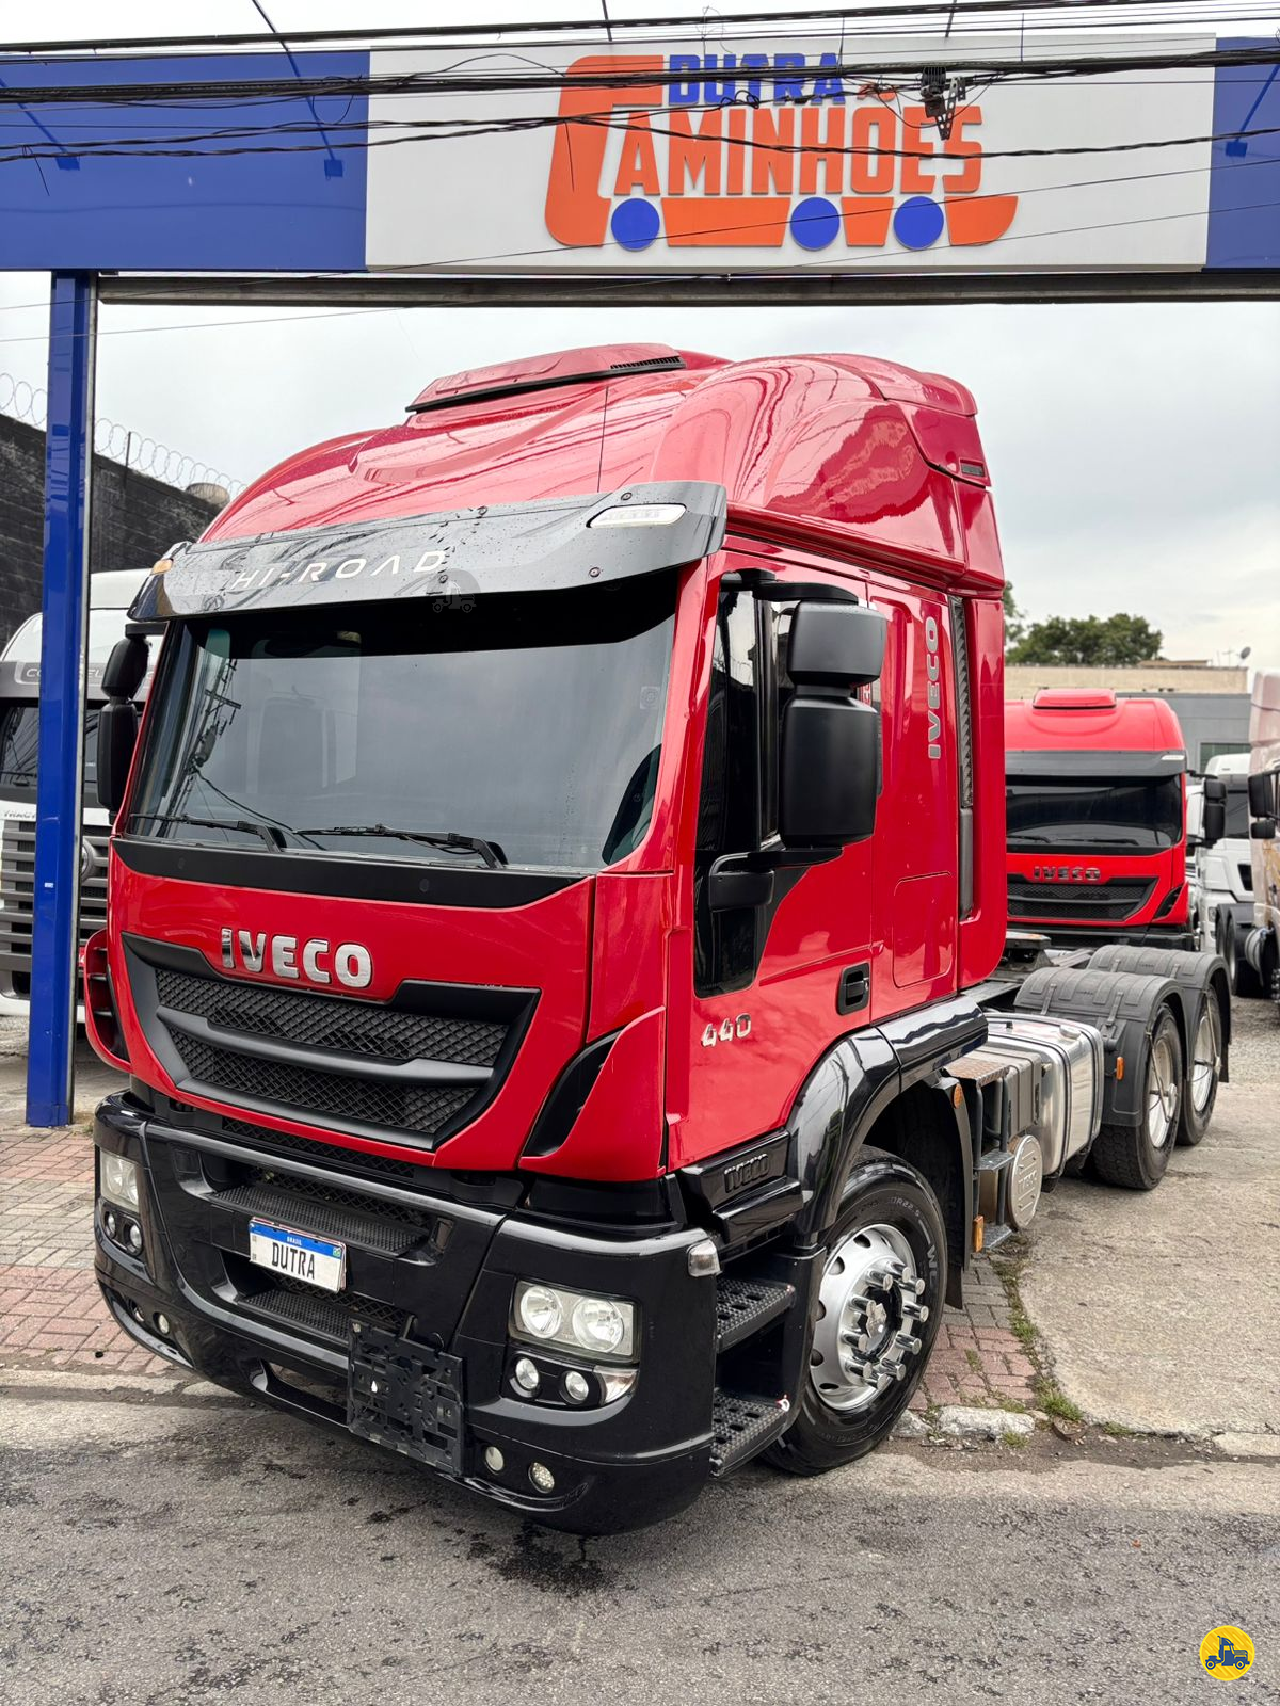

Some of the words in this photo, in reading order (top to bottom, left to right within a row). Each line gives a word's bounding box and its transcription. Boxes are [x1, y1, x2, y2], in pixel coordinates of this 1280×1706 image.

[669, 52, 846, 104] DUTRA
[230, 550, 447, 591] HI-ROAD
[925, 616, 941, 759] IVECO
[1033, 866, 1101, 881] IVECO
[220, 927, 373, 988] IVECO
[701, 1012, 752, 1047] 440
[272, 1242, 315, 1280] DUTRA
